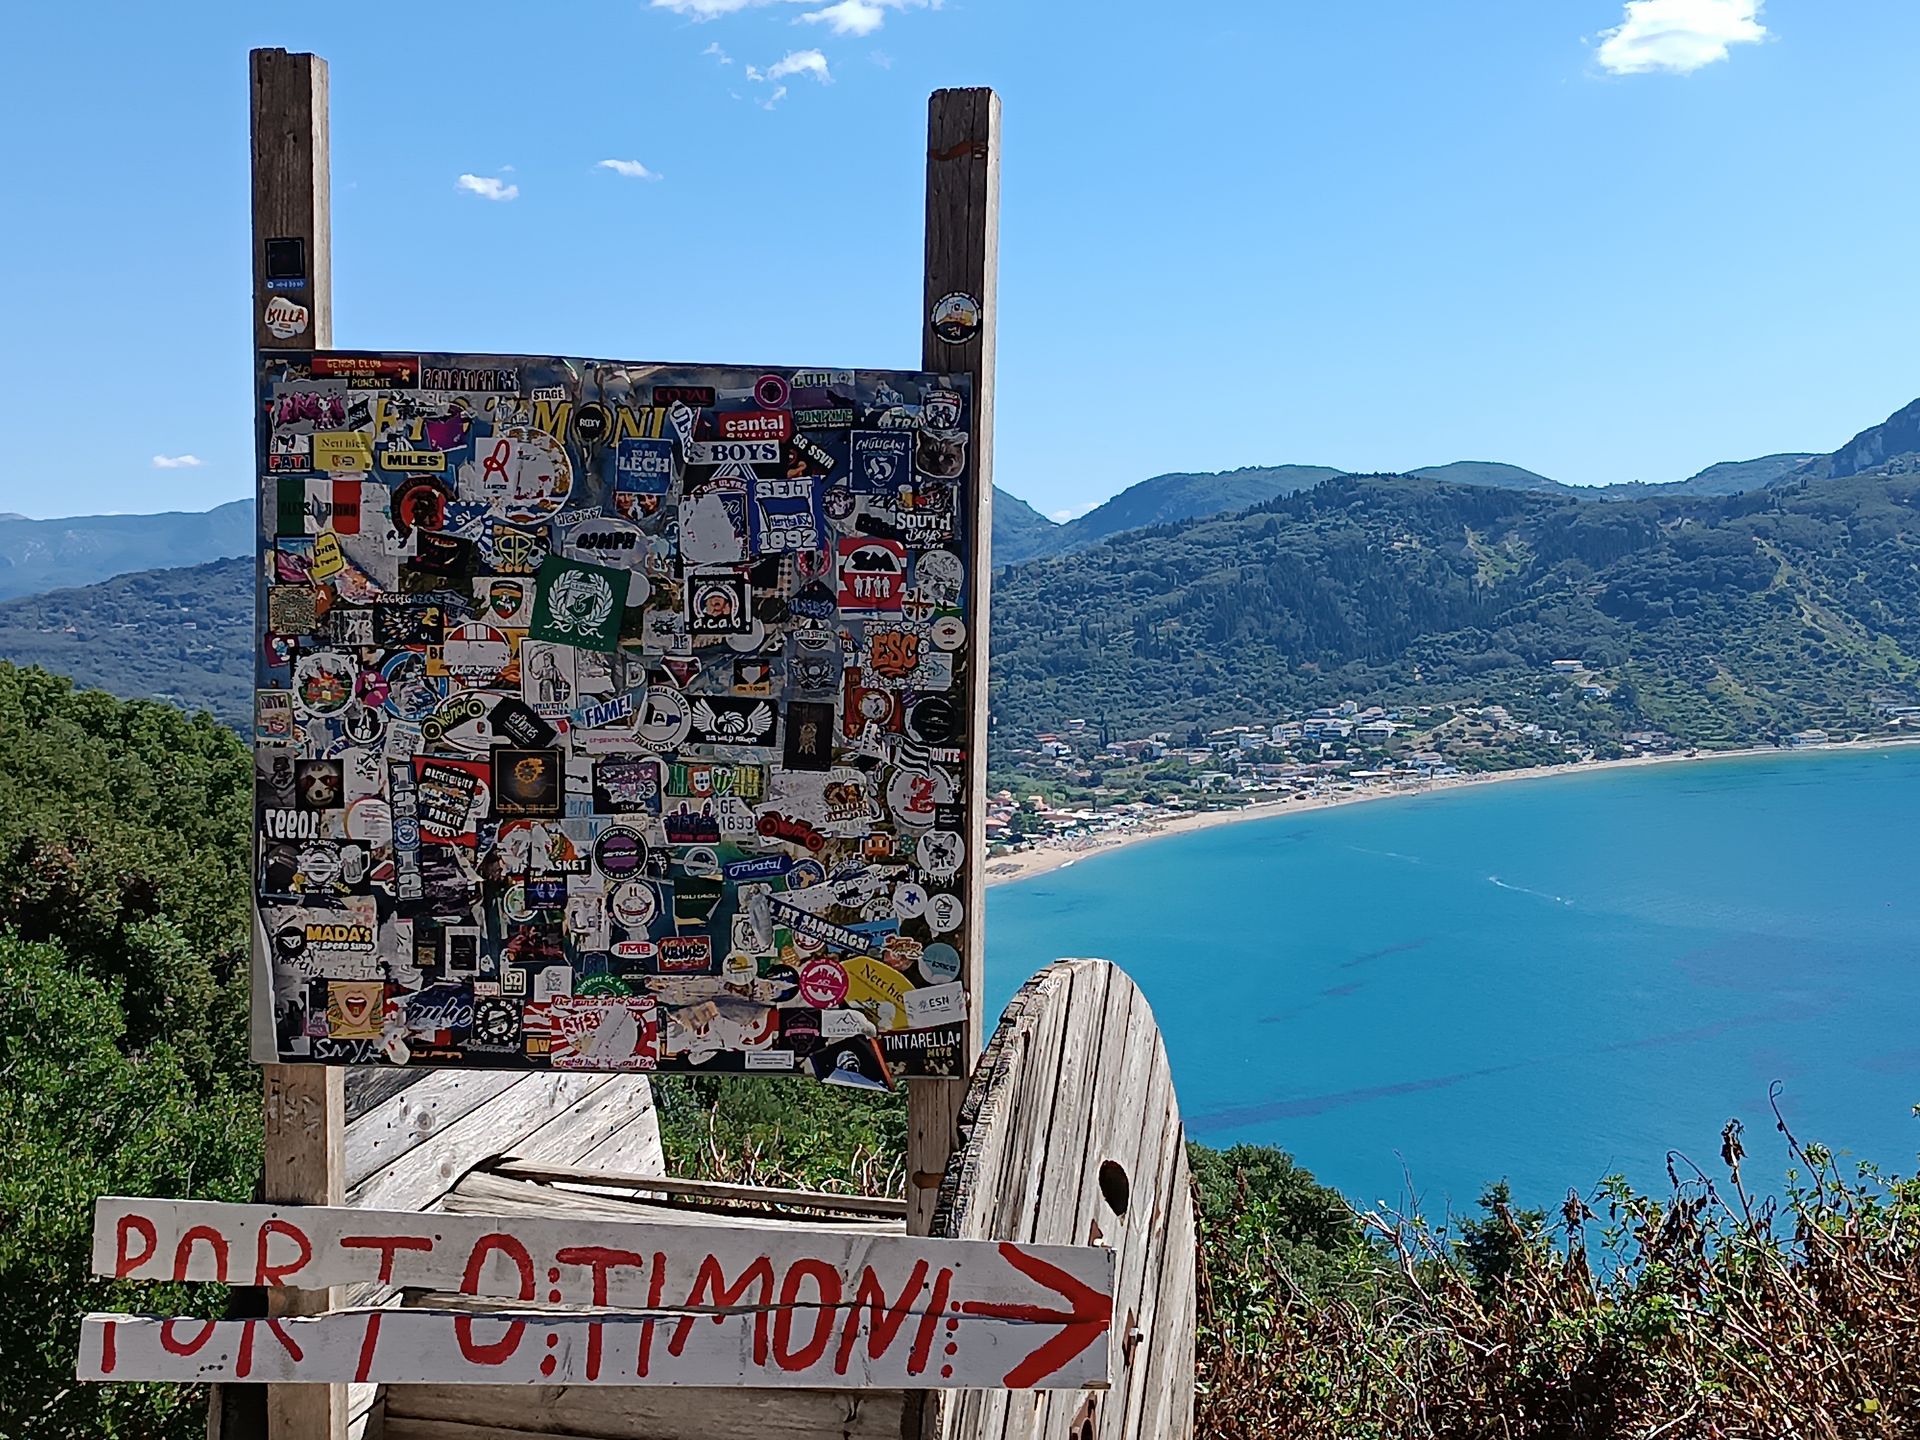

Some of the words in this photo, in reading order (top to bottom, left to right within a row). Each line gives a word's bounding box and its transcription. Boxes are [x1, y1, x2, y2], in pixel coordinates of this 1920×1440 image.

[267, 308, 306, 325] KILLA
[358, 358, 382, 368] CLUB
[351, 378, 392, 388] PONENTE
[533, 388, 564, 400] STAGE
[725, 414, 785, 431] cantal
[387, 454, 439, 467] MILES
[711, 443, 779, 461] BOYS
[619, 457, 670, 473] LECH
[755, 479, 813, 498] SEIT
[896, 512, 951, 530] SOUTH
[758, 529, 819, 550] 1892
[585, 695, 632, 728] FAME!
[720, 800, 737, 815] GE
[720, 816, 753, 831] 1893
[306, 925, 372, 942] MADA's
[860, 963, 887, 989] Nett
[928, 996, 950, 1008] ESN
[884, 1031, 961, 1052] TINTARELLA!
